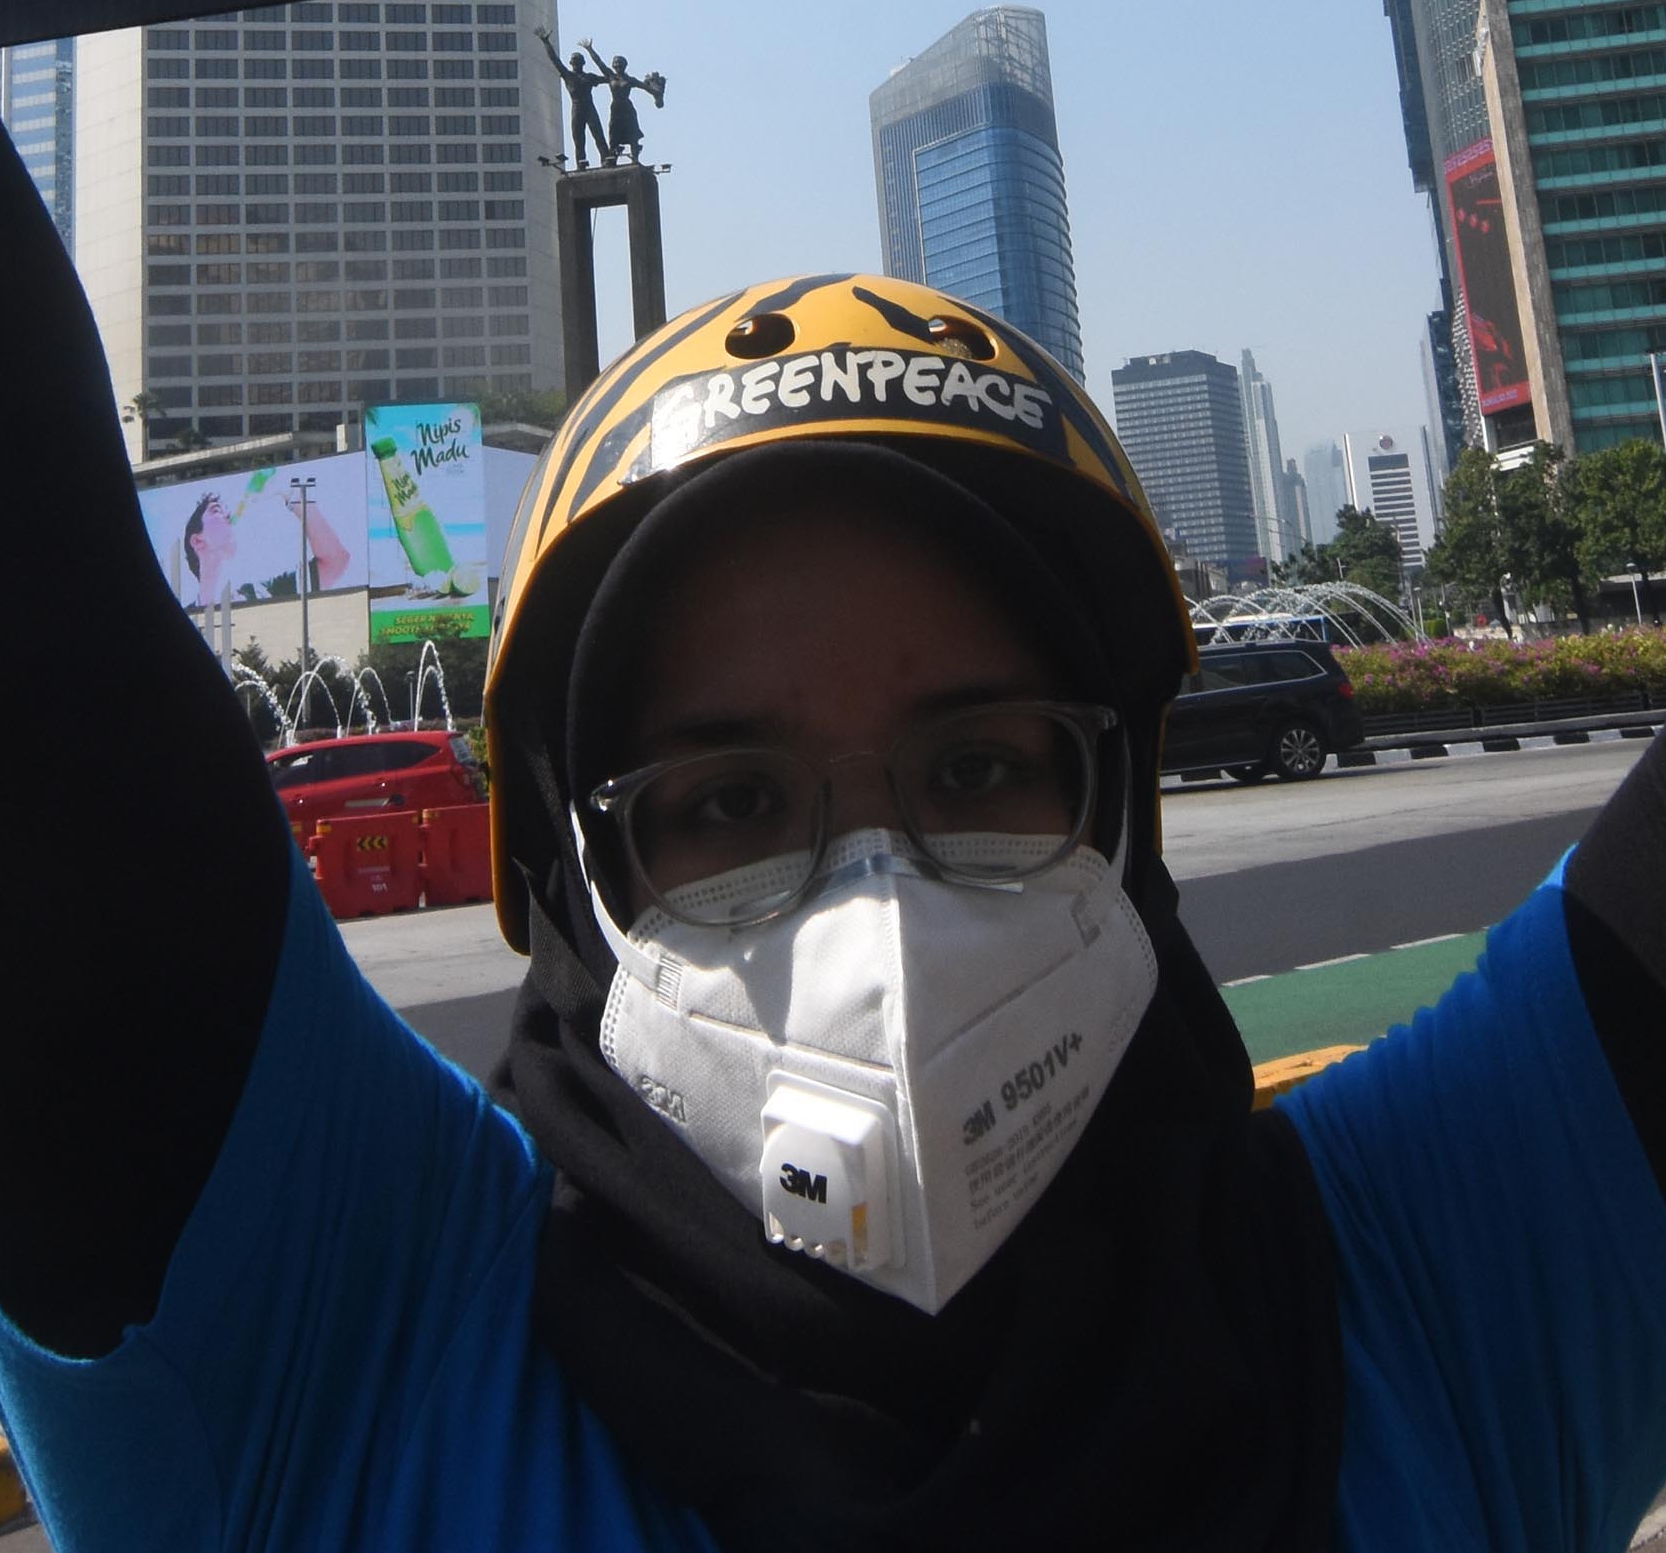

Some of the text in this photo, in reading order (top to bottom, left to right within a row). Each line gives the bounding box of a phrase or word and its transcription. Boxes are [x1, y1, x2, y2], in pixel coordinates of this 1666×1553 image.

[651, 349, 1054, 447] GREENPEACE
[416, 417, 461, 446] Nipis
[411, 439, 469, 475] Madu
[640, 1074, 687, 1124] 3M
[962, 1099, 997, 1146] 3M
[1000, 1031, 1083, 1112] 9501V+
[779, 1162, 828, 1205] 3M
